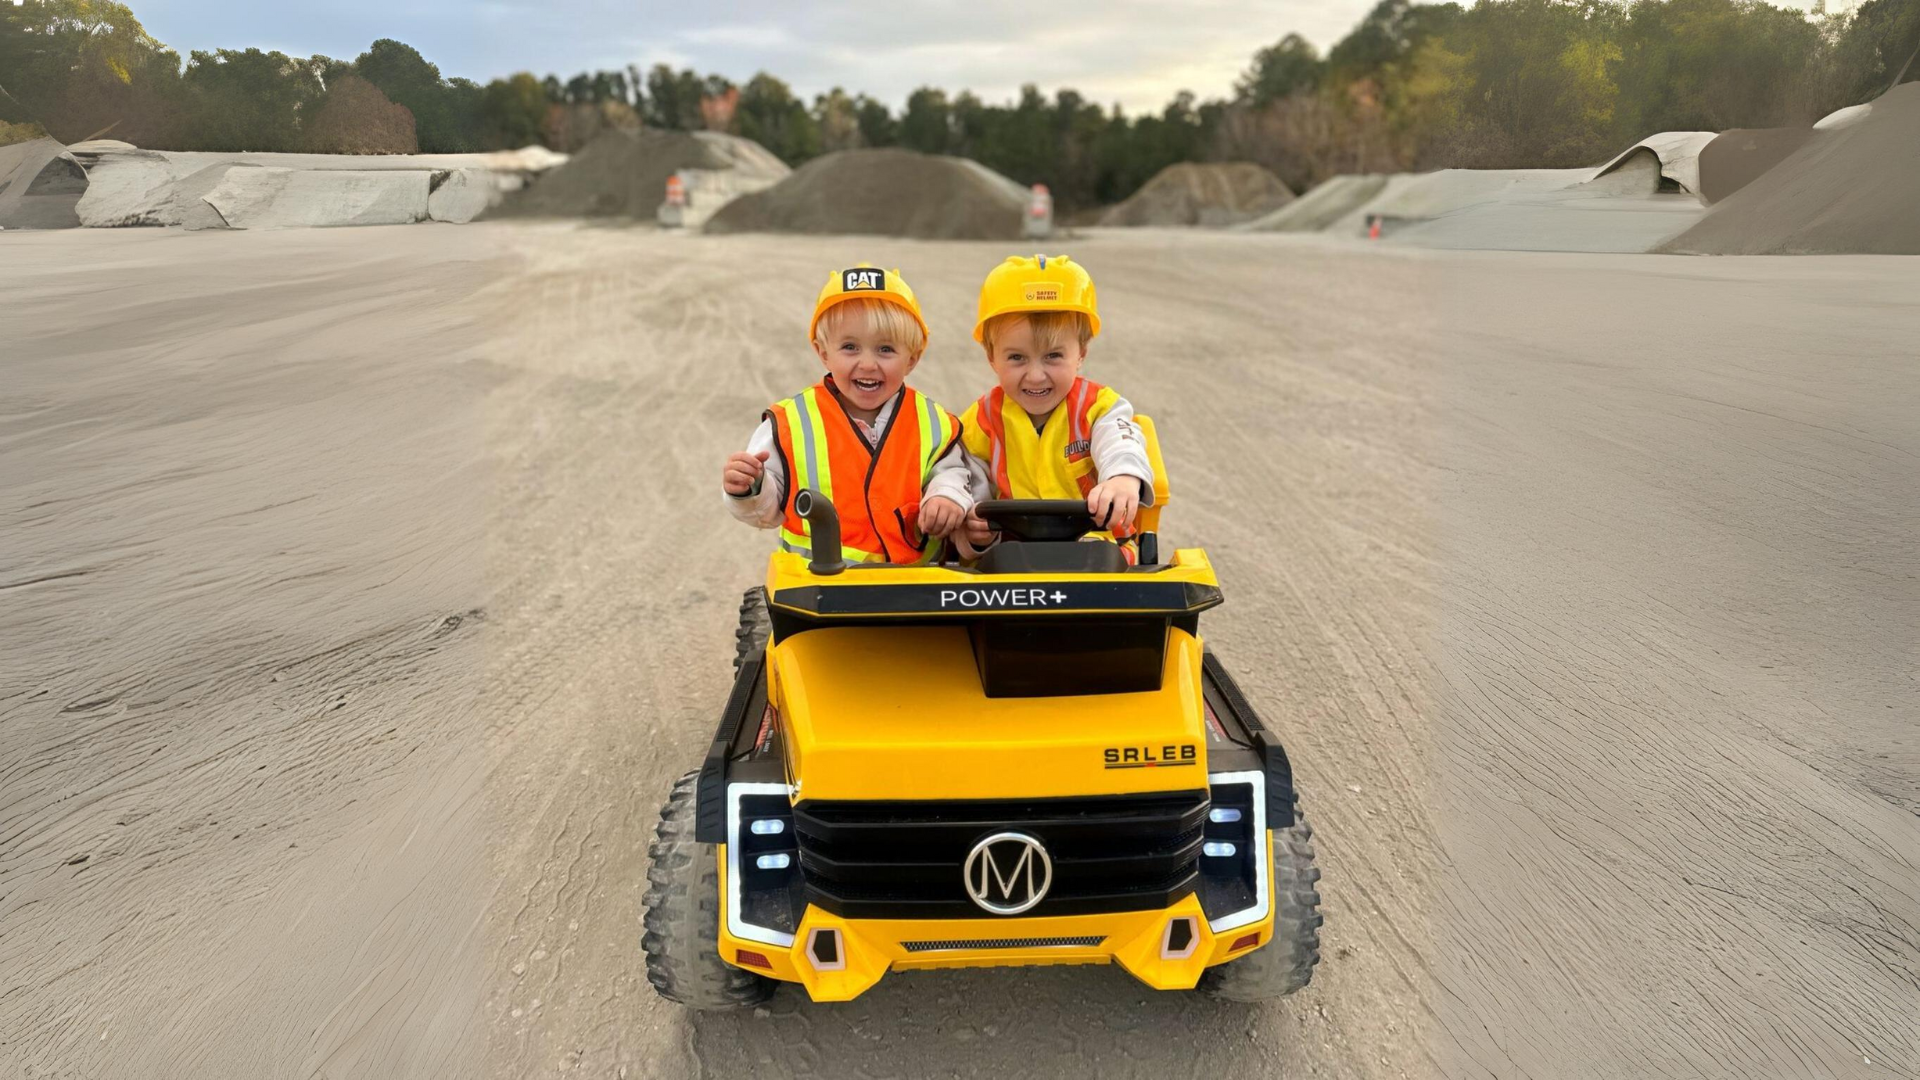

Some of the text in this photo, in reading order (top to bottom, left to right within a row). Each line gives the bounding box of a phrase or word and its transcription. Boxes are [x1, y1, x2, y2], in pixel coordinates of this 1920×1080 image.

[847, 271, 878, 290] CAT
[940, 588, 1068, 608] POWER+
[1104, 744, 1197, 763] SRLEB
